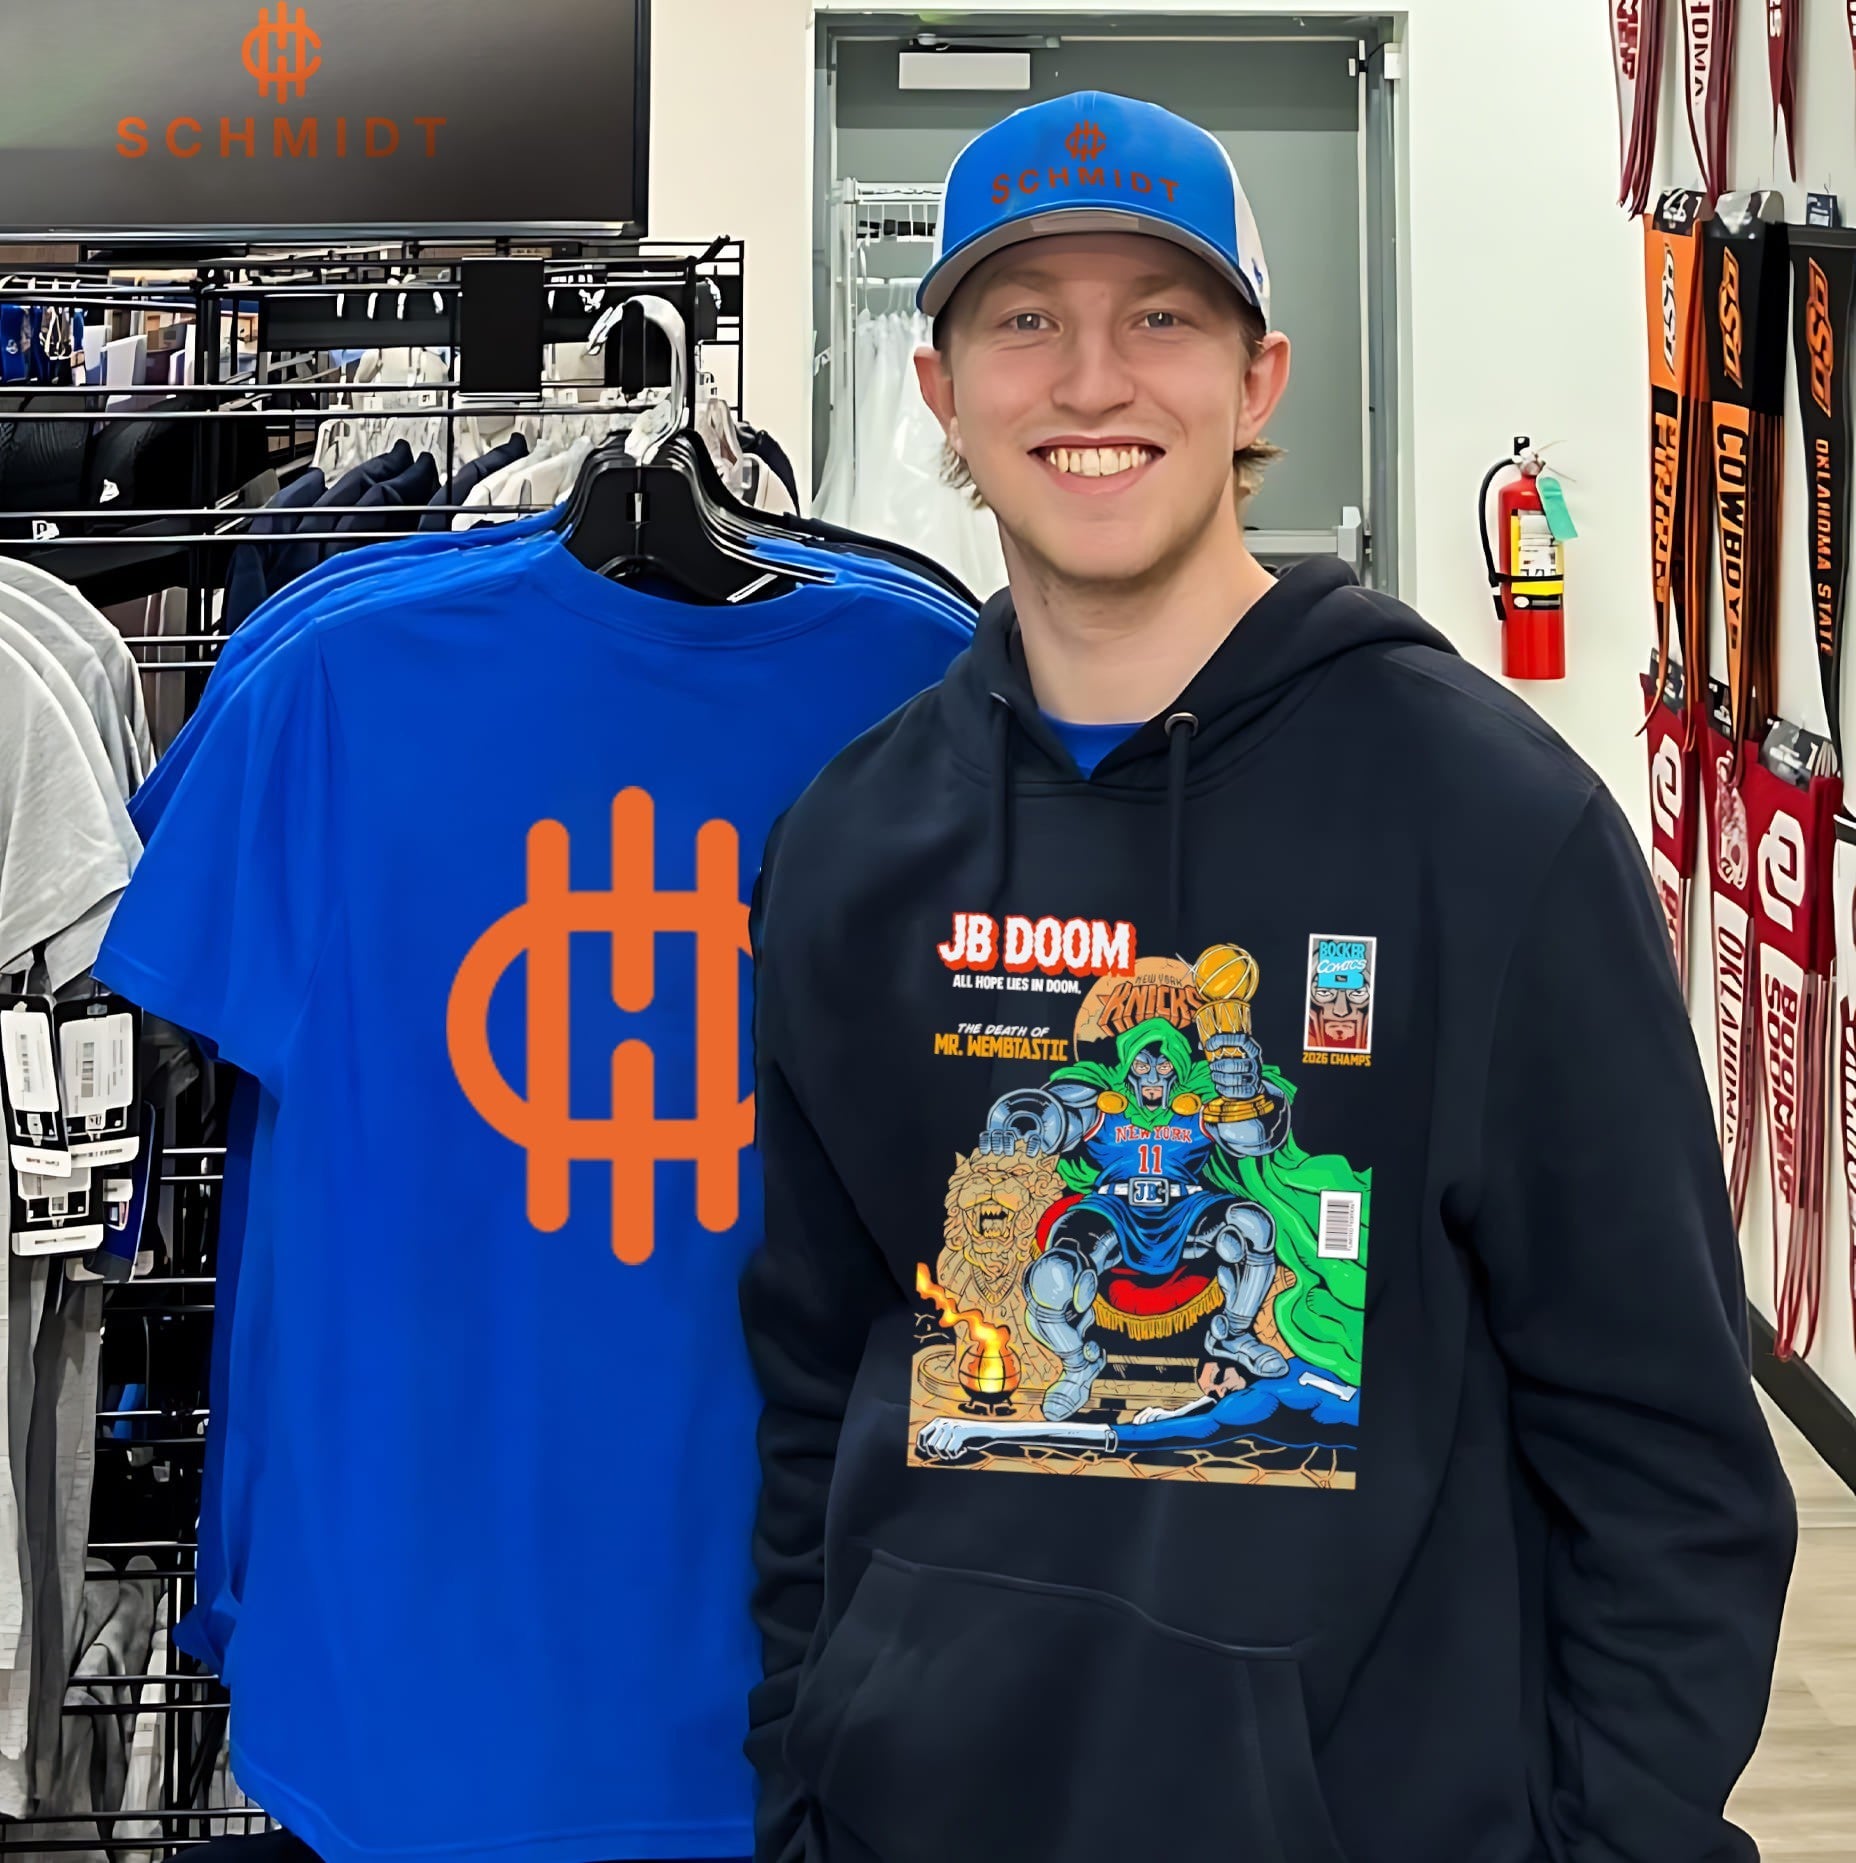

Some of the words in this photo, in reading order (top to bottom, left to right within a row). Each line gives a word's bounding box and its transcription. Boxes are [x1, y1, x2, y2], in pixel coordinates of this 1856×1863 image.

[115, 116, 448, 159] SCHMIDT
[991, 166, 1179, 204] SCHMIDT
[1814, 437, 1832, 570] OKLAHOMA
[1818, 582, 1834, 657] STATE
[937, 912, 999, 972] JB
[1003, 915, 1137, 977] DOOM
[1319, 941, 1366, 959] BOCKER
[952, 974, 973, 988] ALL
[975, 975, 1004, 990] HOPE
[1006, 977, 1029, 991] LIES
[1030, 978, 1044, 992] IN
[1046, 979, 1082, 994] DOOM.
[1135, 975, 1156, 984] NEW
[1158, 973, 1183, 987] YORK
[957, 1023, 982, 1034] THE
[984, 1024, 1028, 1037] DEATH
[1030, 1026, 1050, 1038] OF
[1718, 925, 1745, 1144] OKLAHOMA
[934, 1033, 964, 1056] MR.
[967, 1034, 1069, 1061] WEMBTASTIC
[1302, 1051, 1329, 1064] 2026
[1330, 1053, 1373, 1067] CHAMPS
[1115, 1124, 1151, 1143] NEW
[1153, 1126, 1192, 1143] YORK
[1138, 1144, 1162, 1174] 11
[1135, 1183, 1159, 1201] JB
